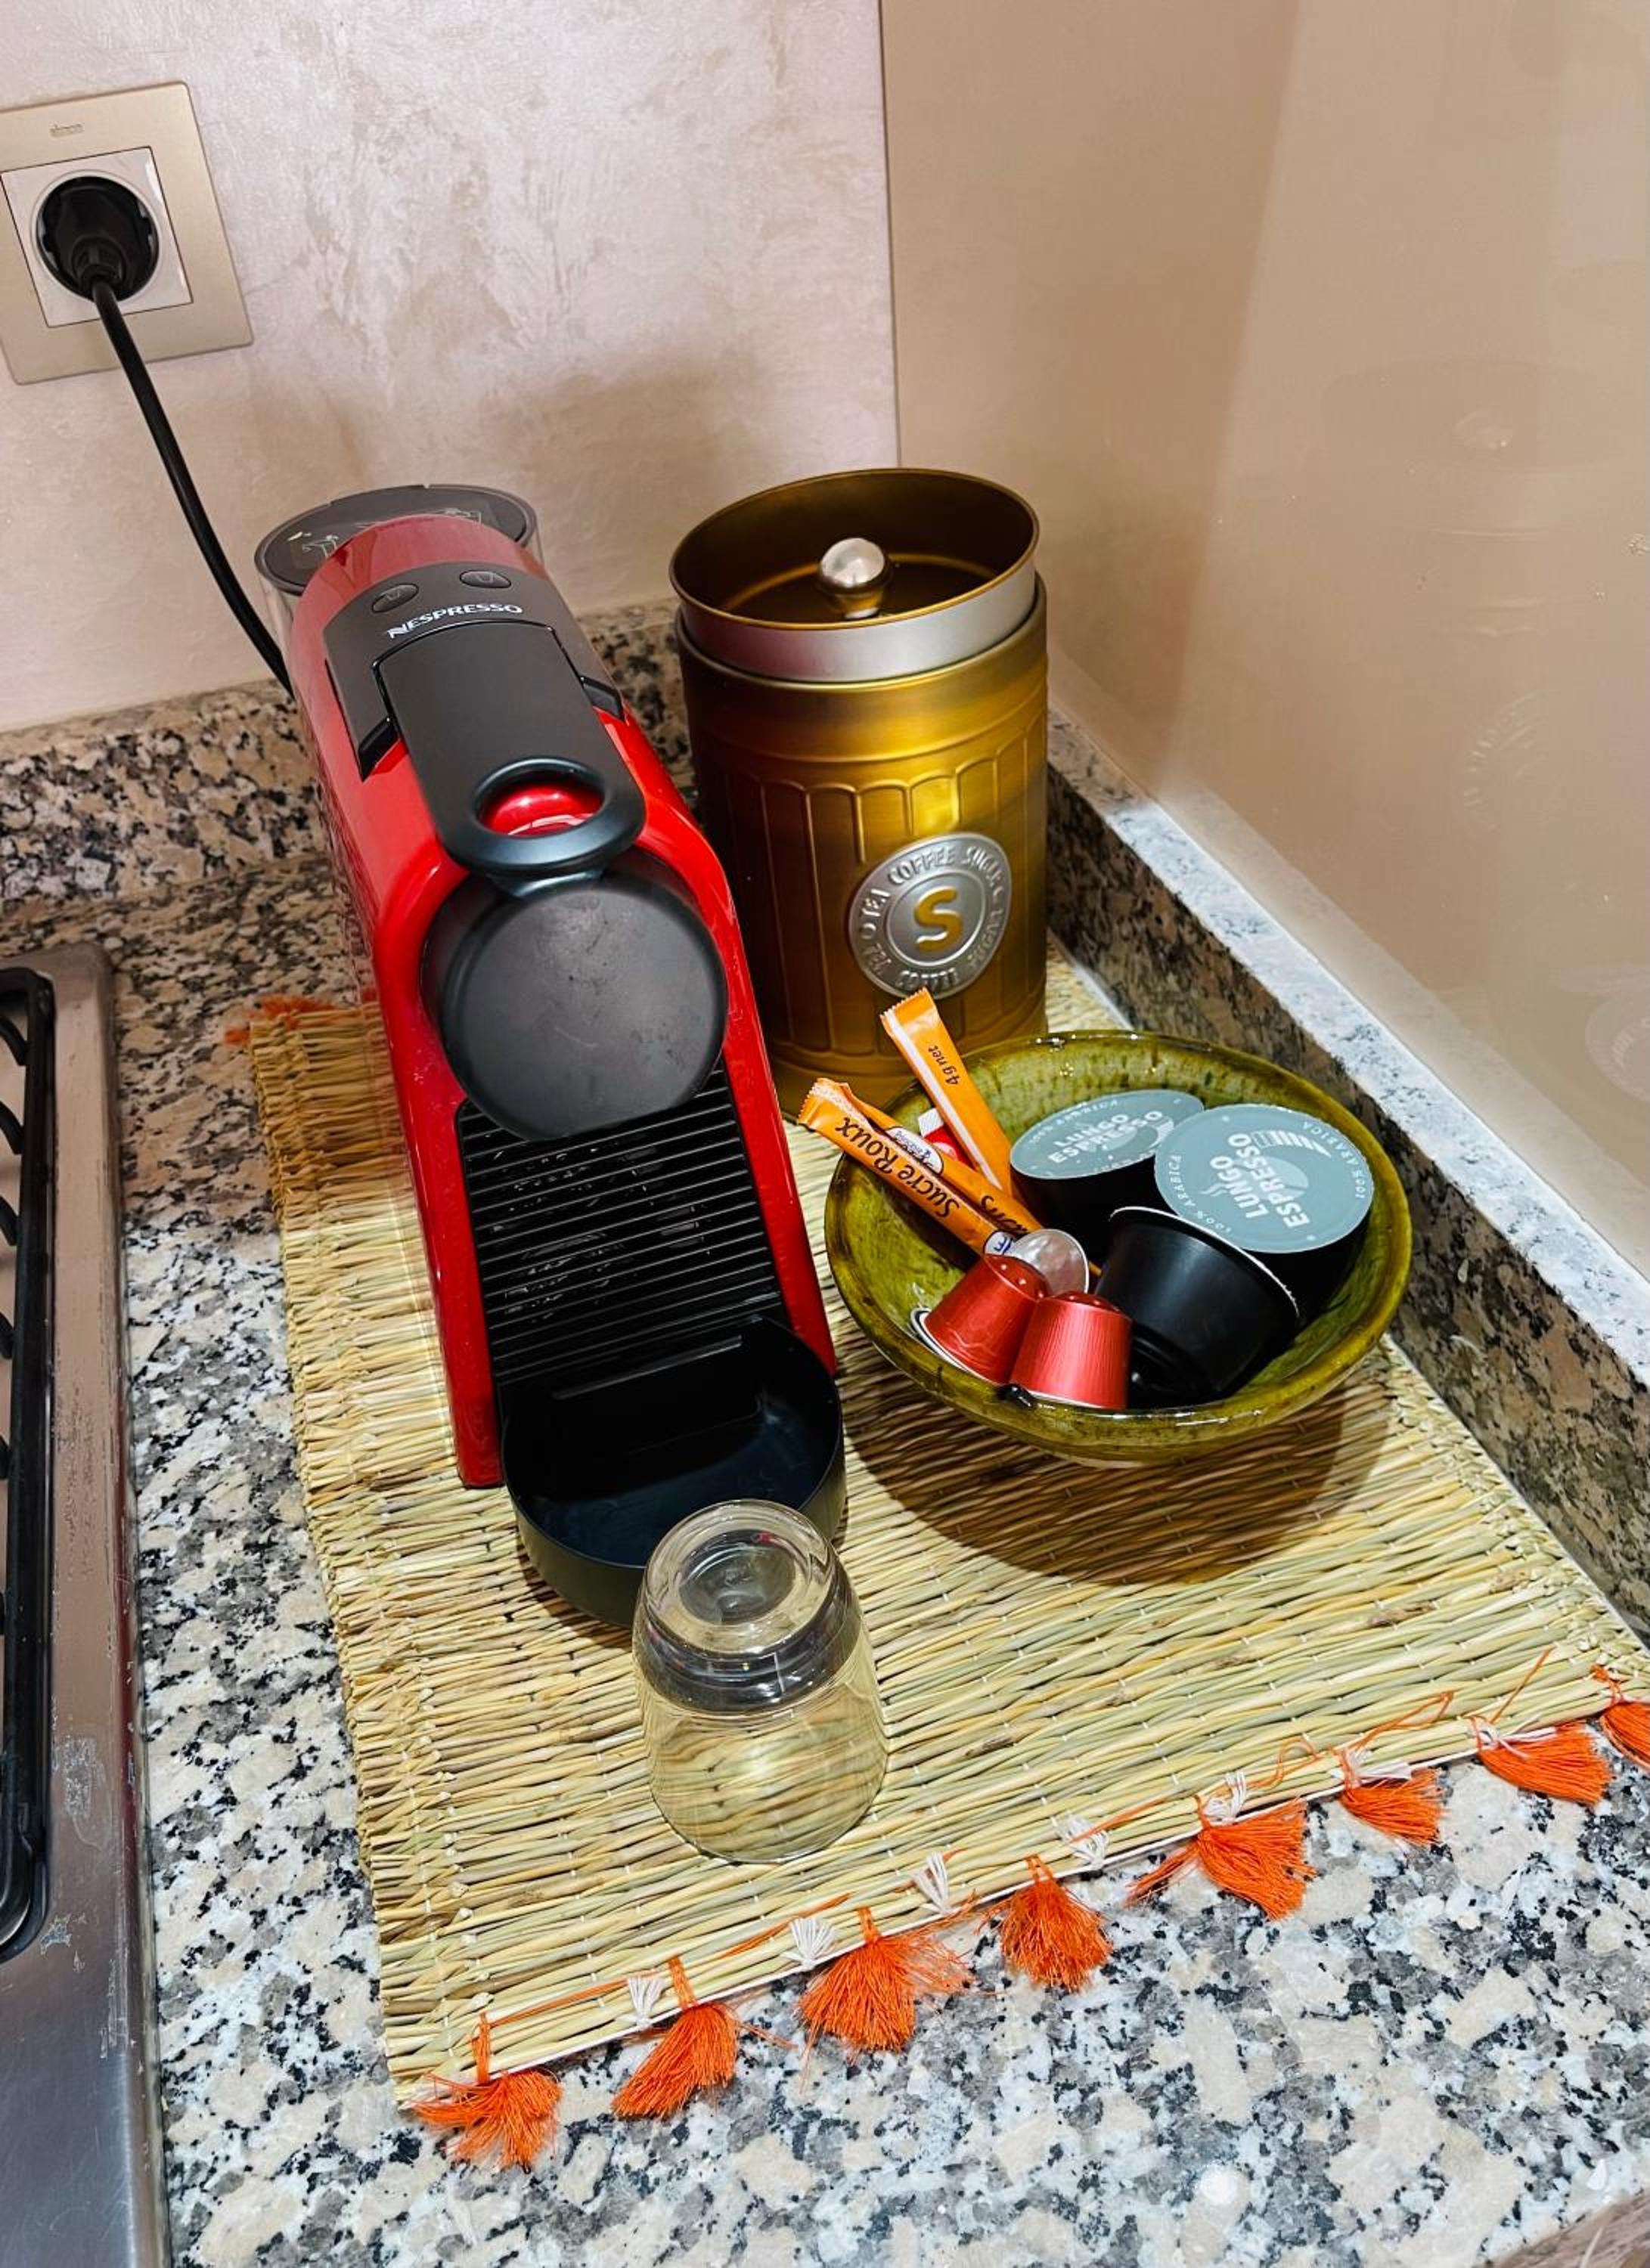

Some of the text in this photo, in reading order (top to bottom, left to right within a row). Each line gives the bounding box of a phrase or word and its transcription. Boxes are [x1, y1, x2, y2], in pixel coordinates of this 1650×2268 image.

[386, 603, 523, 639] NESPRESSO
[861, 888, 891, 917] TEA
[888, 846, 956, 885] COFFEE
[914, 885, 964, 953] S
[928, 1045, 960, 1085] 4g net
[833, 1116, 894, 1175] Roux
[1047, 1110, 1164, 1164] ESPRESSO
[1053, 1114, 1129, 1148] LUNGO
[900, 1167, 960, 1219] Sucre
[1210, 1155, 1270, 1219] LUNGO
[1227, 1132, 1310, 1228] ESPRESSO
